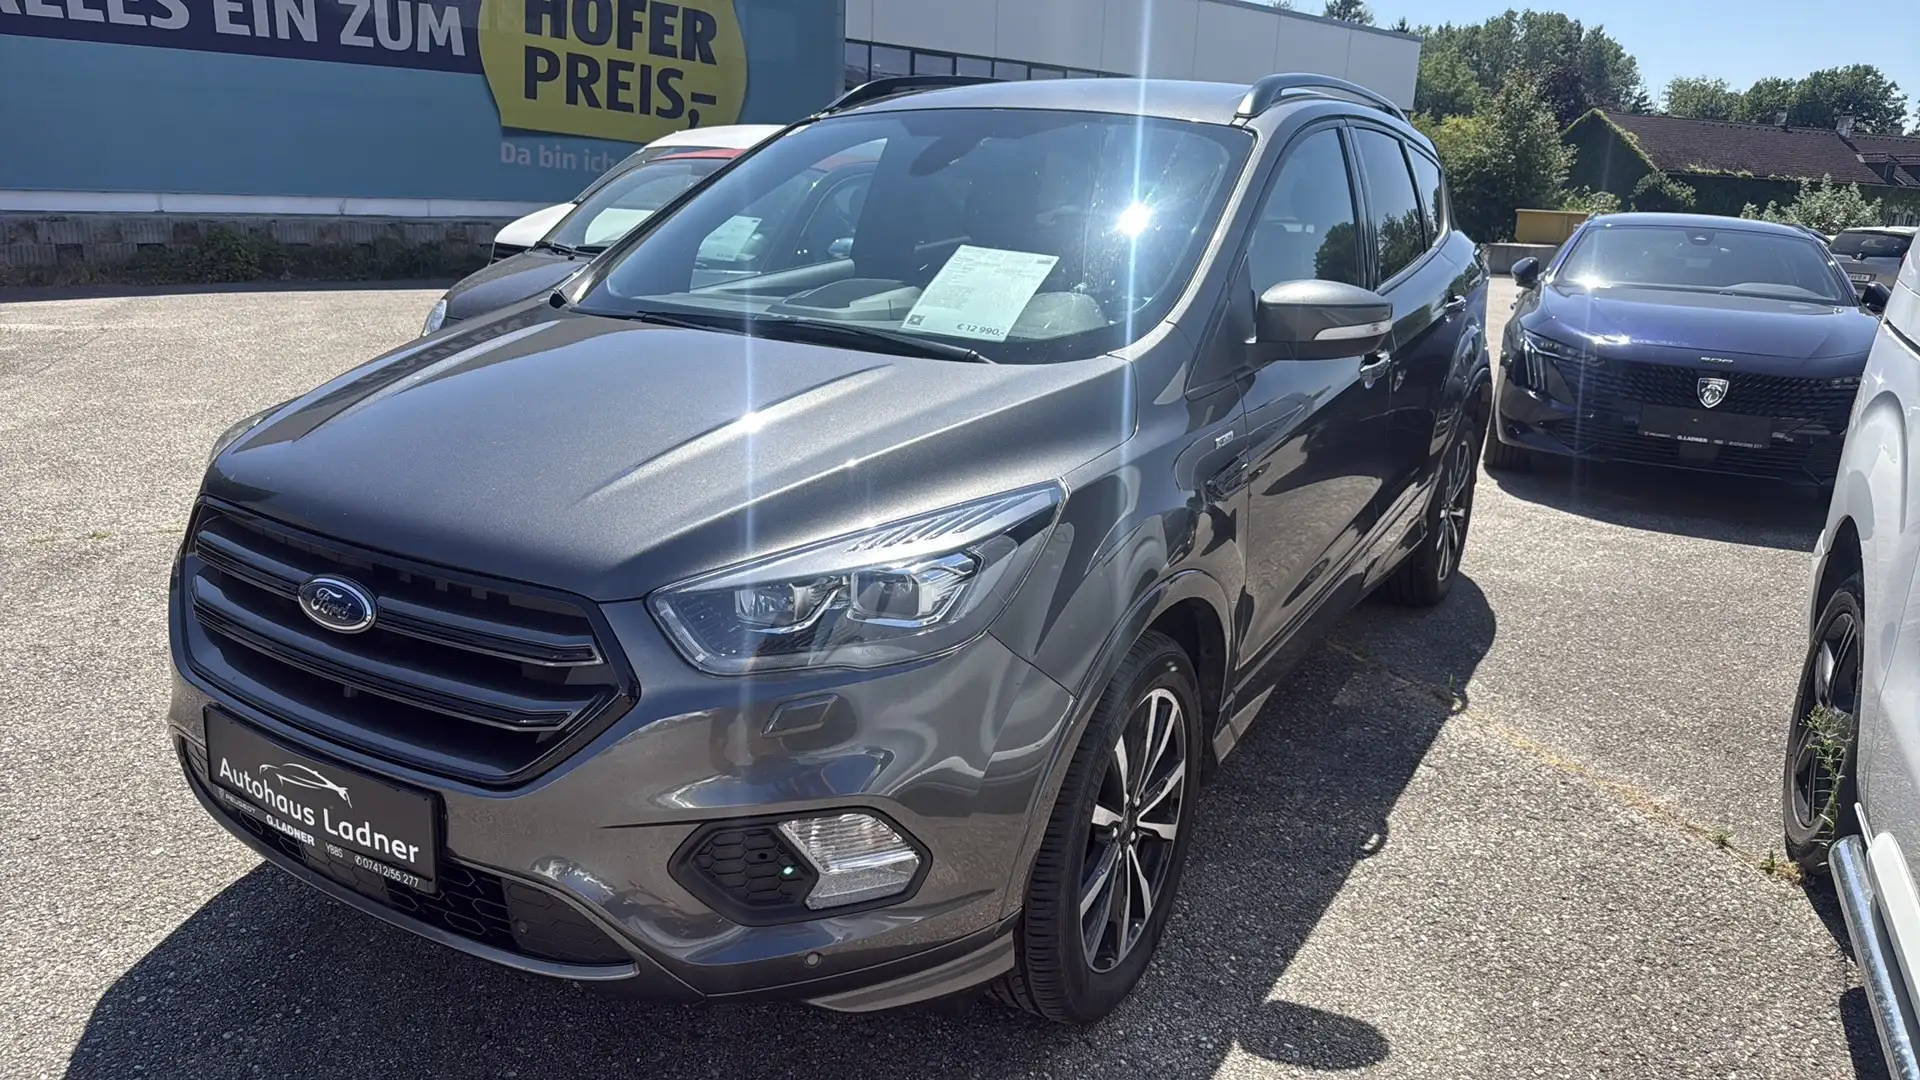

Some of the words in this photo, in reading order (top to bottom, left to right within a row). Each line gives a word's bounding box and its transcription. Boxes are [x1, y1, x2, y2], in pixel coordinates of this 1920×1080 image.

[214, 0, 318, 42] EIN
[338, 0, 466, 56] ZUM
[524, 0, 717, 66] HOFER
[501, 141, 531, 166] Da
[539, 144, 578, 170] bin
[966, 324, 978, 332] 12
[310, 587, 353, 620] Ford
[219, 757, 316, 826] Autohaus
[323, 808, 420, 864] Ladner
[225, 793, 256, 814] PEUGEOT
[266, 814, 315, 847] G.LADNER
[402, 873, 419, 888] 277
